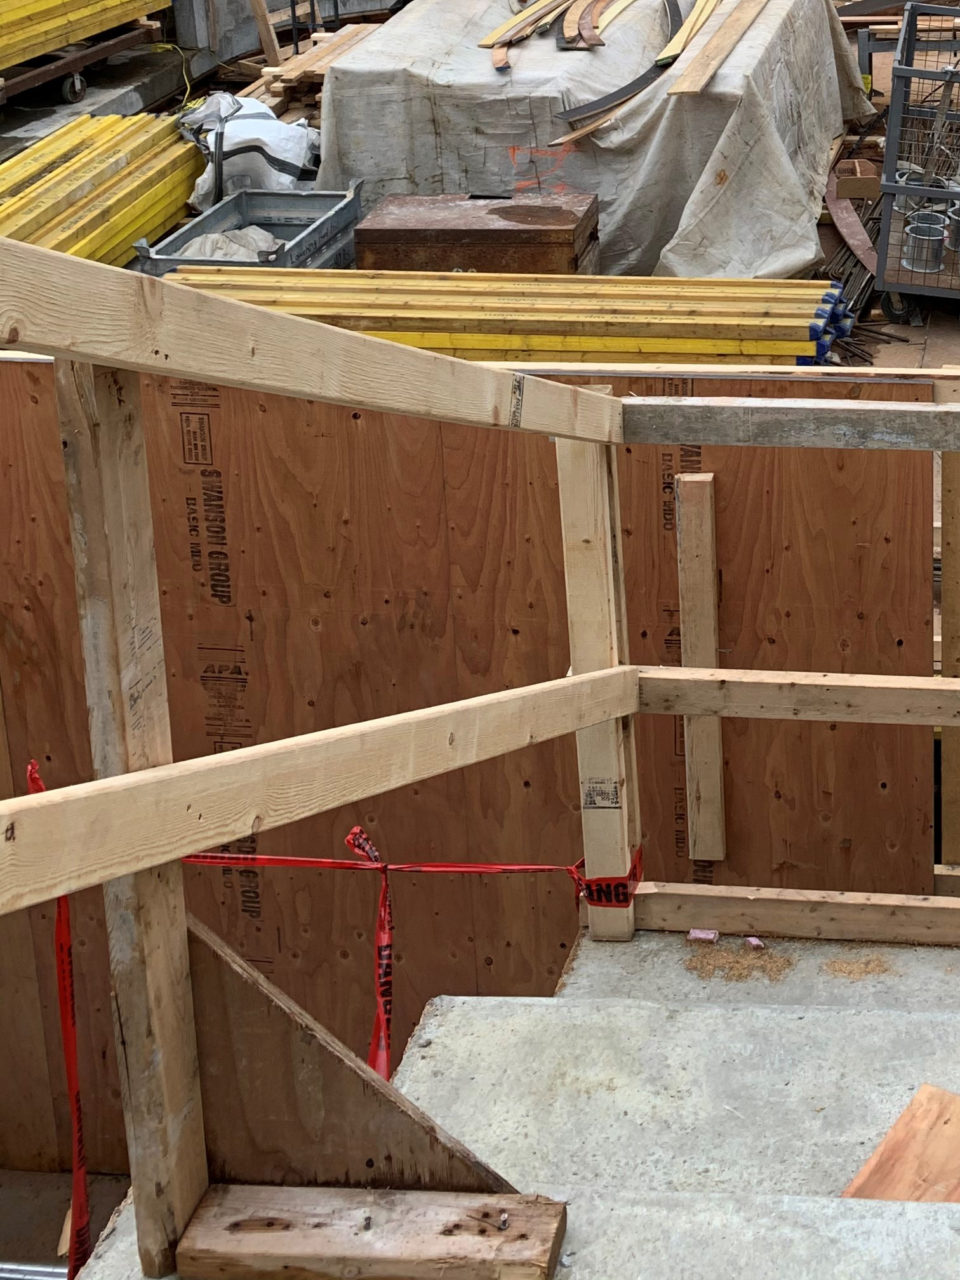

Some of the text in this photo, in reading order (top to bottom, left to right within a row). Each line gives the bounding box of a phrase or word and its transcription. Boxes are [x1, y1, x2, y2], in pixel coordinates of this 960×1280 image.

[185, 496, 199, 537] BASIC
[200, 468, 232, 605] SWANSON GROUP
[203, 663, 243, 676] APA
[239, 869, 262, 919] GROUP
